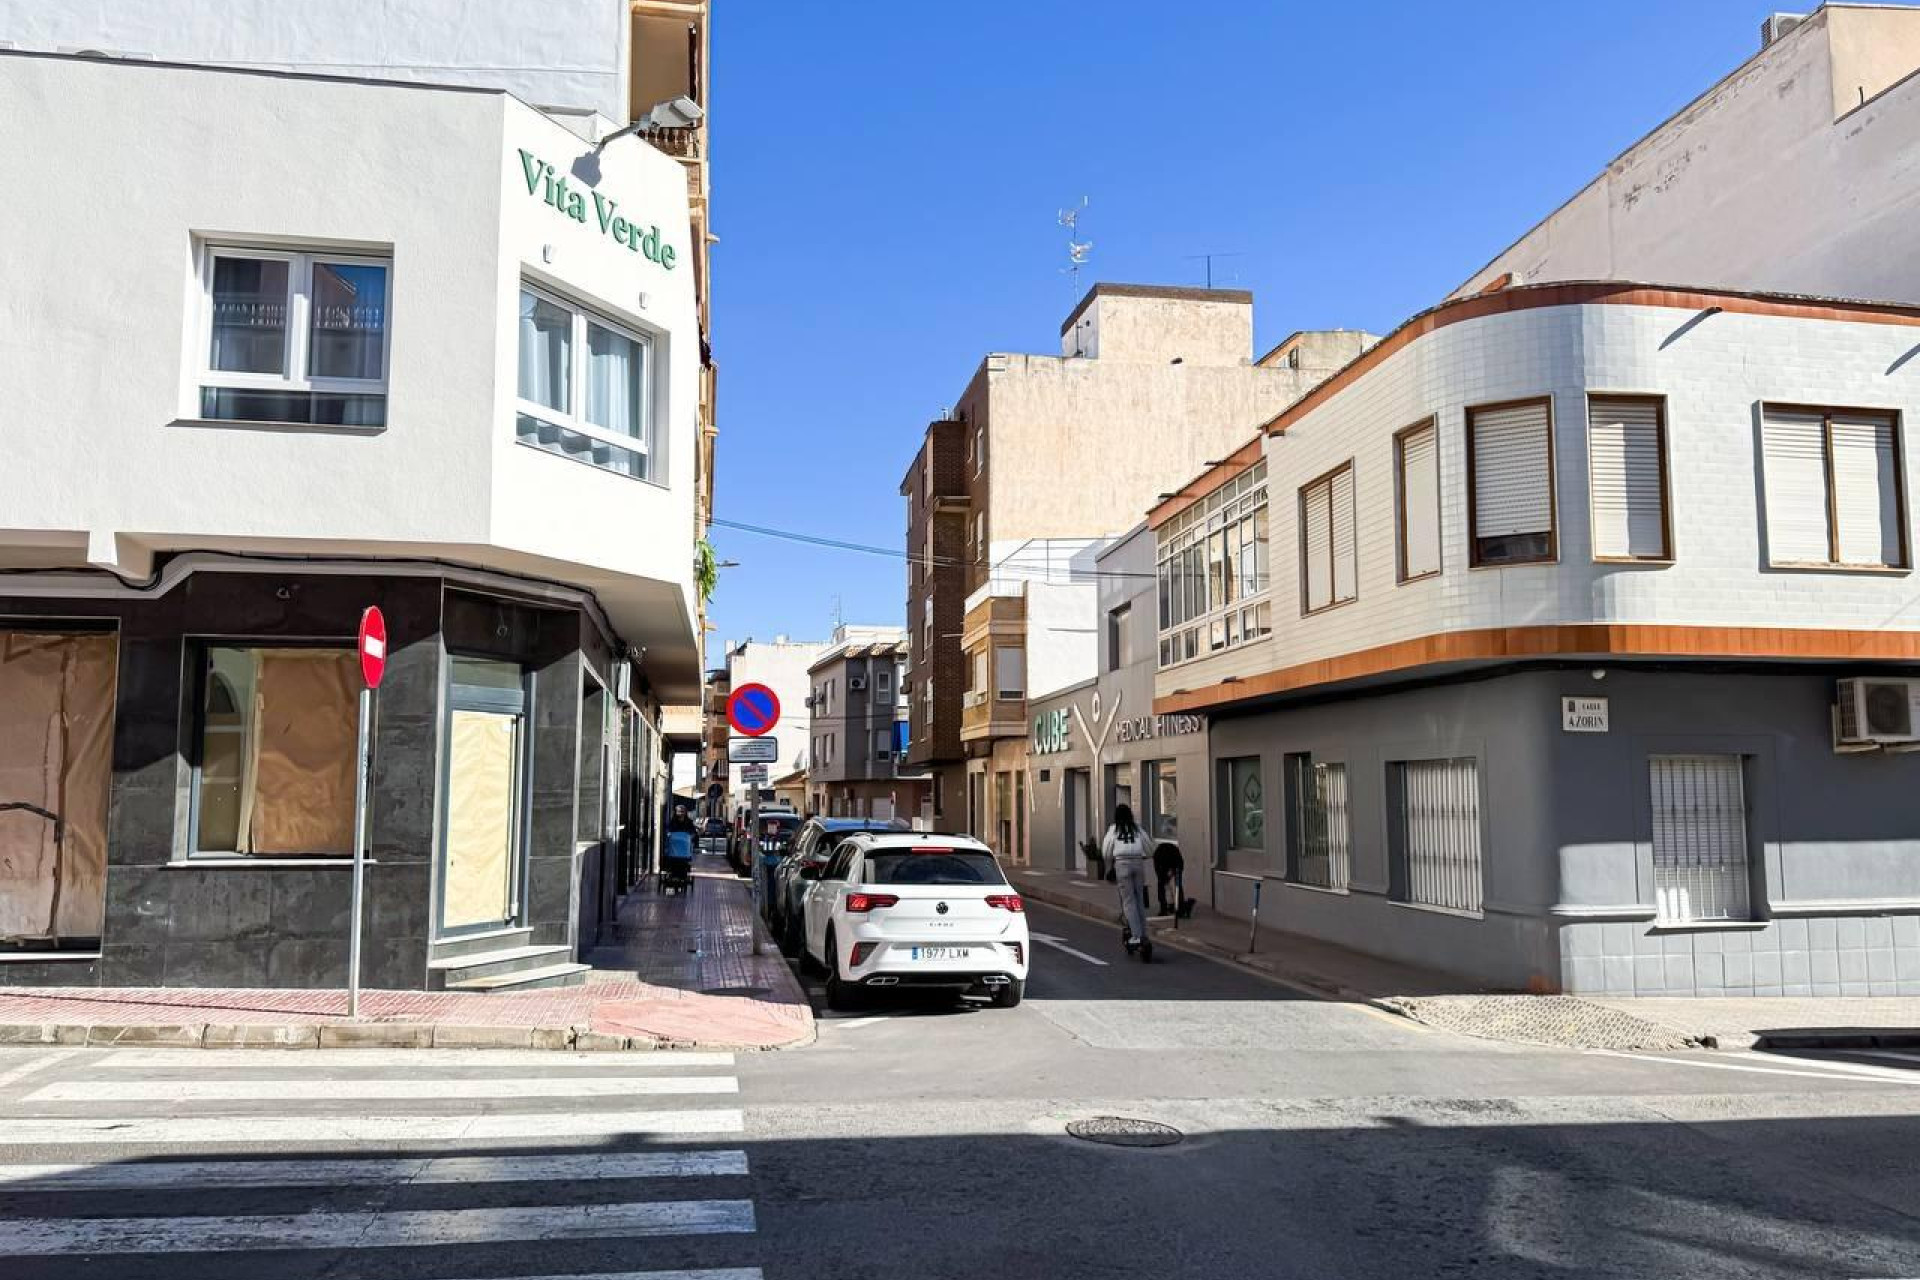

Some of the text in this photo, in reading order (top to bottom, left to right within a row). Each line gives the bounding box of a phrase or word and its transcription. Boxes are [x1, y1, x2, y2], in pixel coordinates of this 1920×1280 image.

[518, 148, 676, 270] Vita Verde
[1034, 707, 1071, 756] CUBE
[922, 948, 969, 959] 1977 LXM
